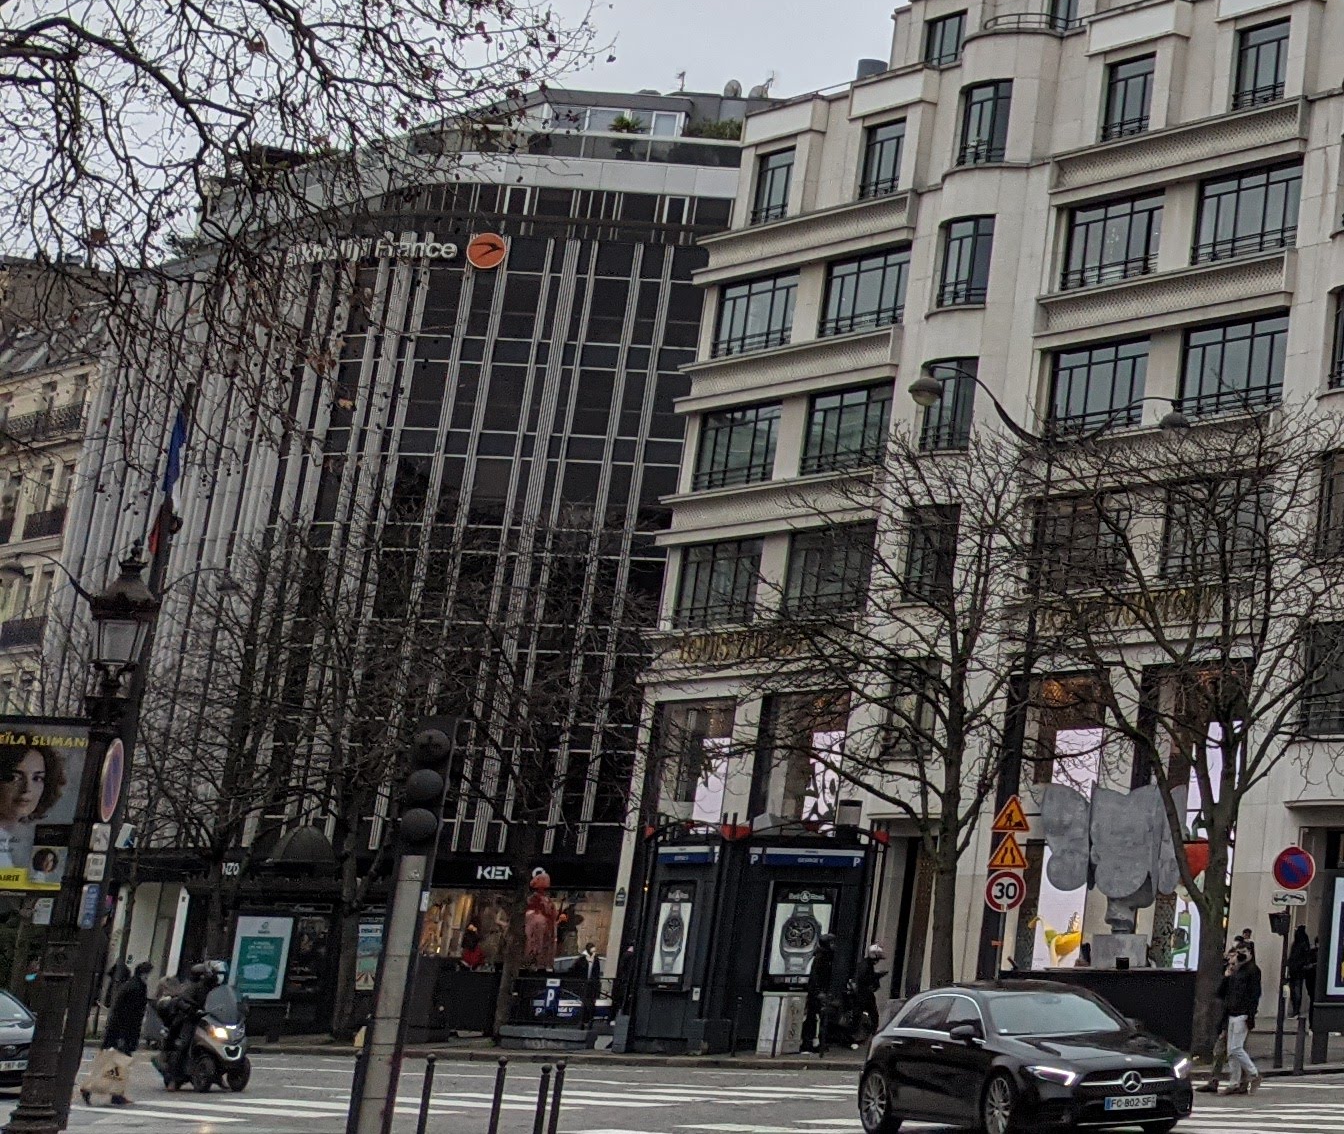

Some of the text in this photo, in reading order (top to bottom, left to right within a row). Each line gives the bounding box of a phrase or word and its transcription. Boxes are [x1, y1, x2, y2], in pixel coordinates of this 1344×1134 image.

[374, 237, 458, 260] France
[476, 865, 548, 880] KENO
[993, 882, 1018, 900] 30
